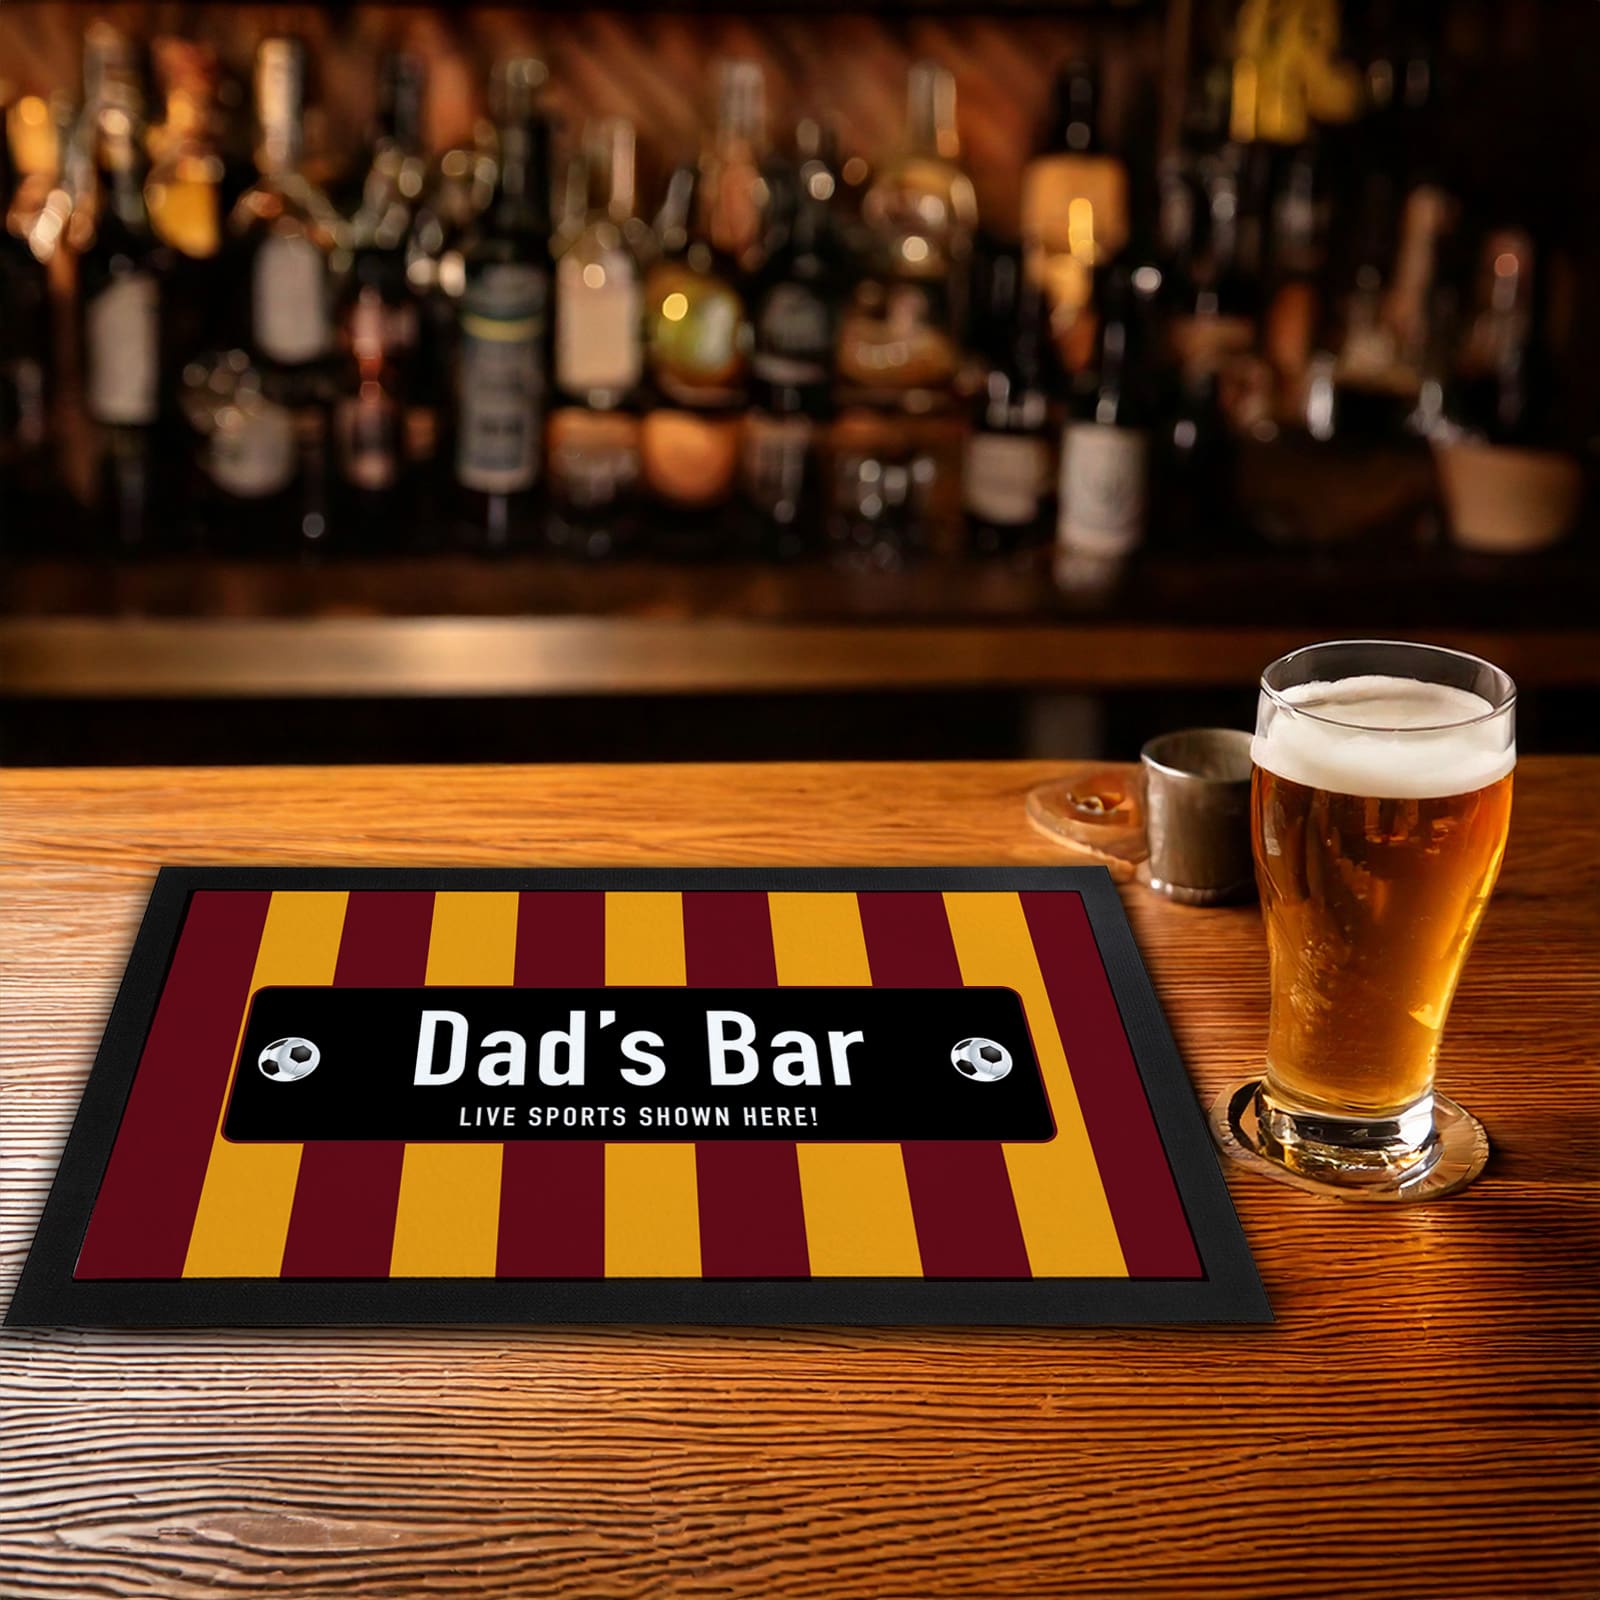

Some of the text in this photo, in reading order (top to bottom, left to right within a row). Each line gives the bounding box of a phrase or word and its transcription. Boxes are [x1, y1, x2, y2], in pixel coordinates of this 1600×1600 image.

[413, 1010, 865, 1087] Dad's Bar
[459, 1106, 819, 1127] LIVE SPORTS SHOWN HERE!
